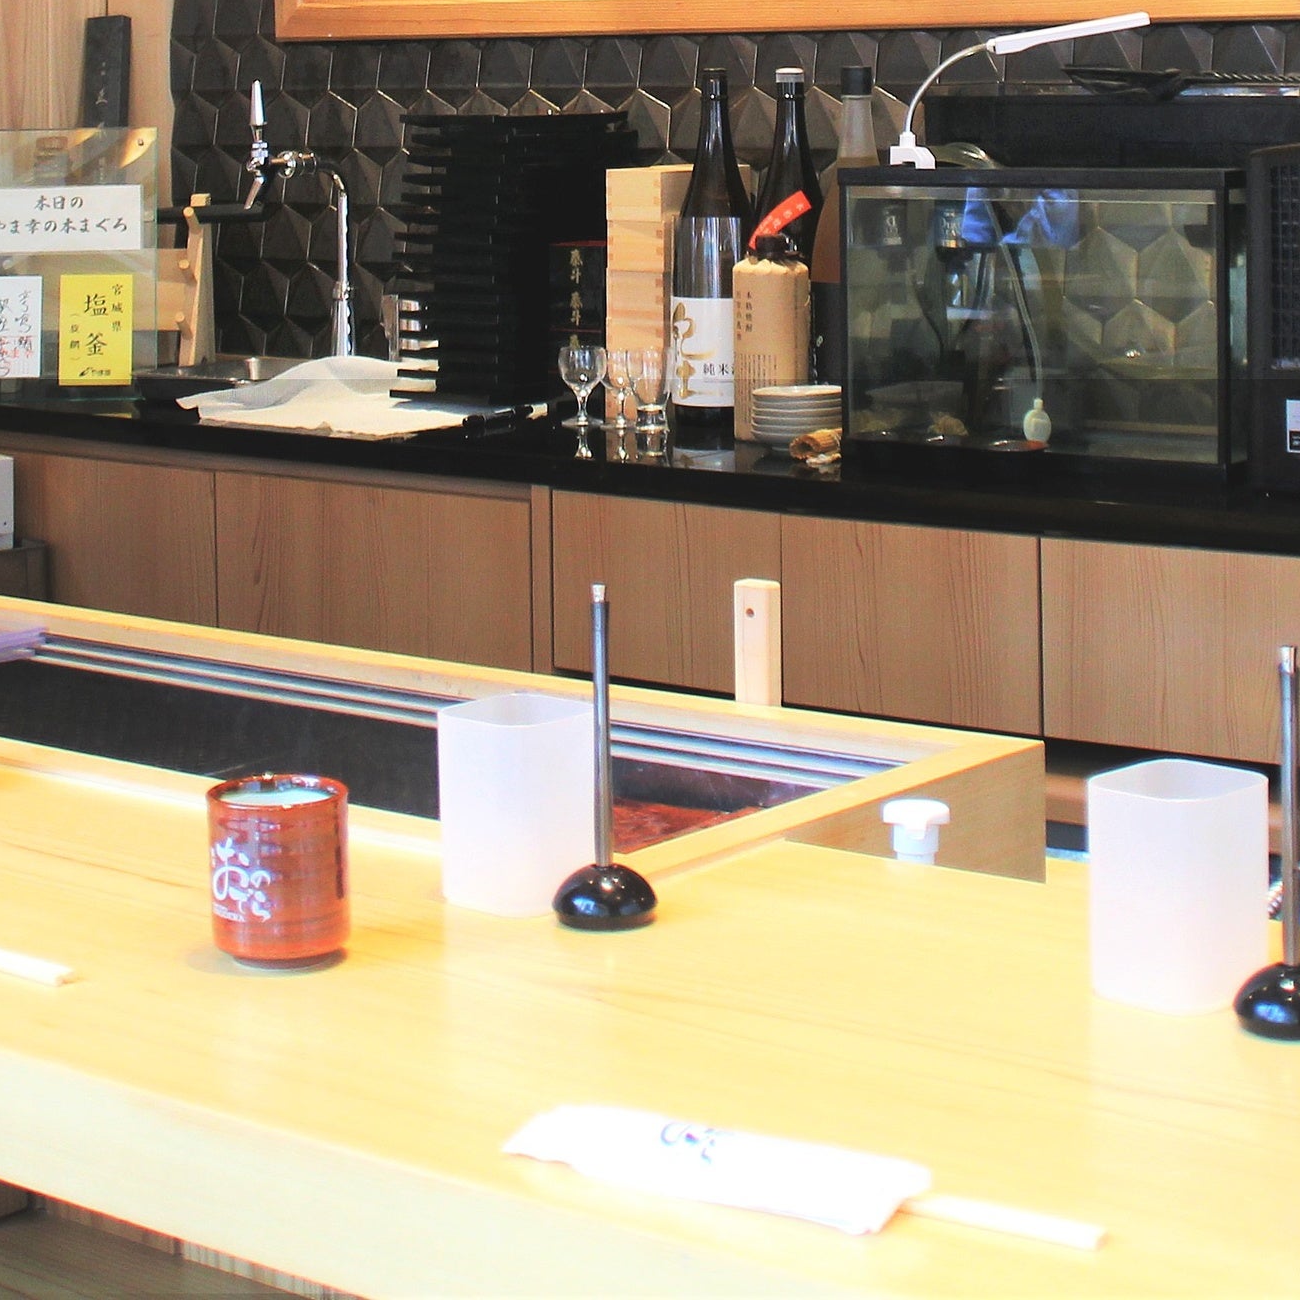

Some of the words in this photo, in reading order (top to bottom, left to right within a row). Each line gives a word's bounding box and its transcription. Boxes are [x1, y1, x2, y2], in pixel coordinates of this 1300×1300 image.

[35, 194, 85, 211] 本日の
[83, 292, 109, 357] 塩釜
[703, 362, 734, 377] 純米
